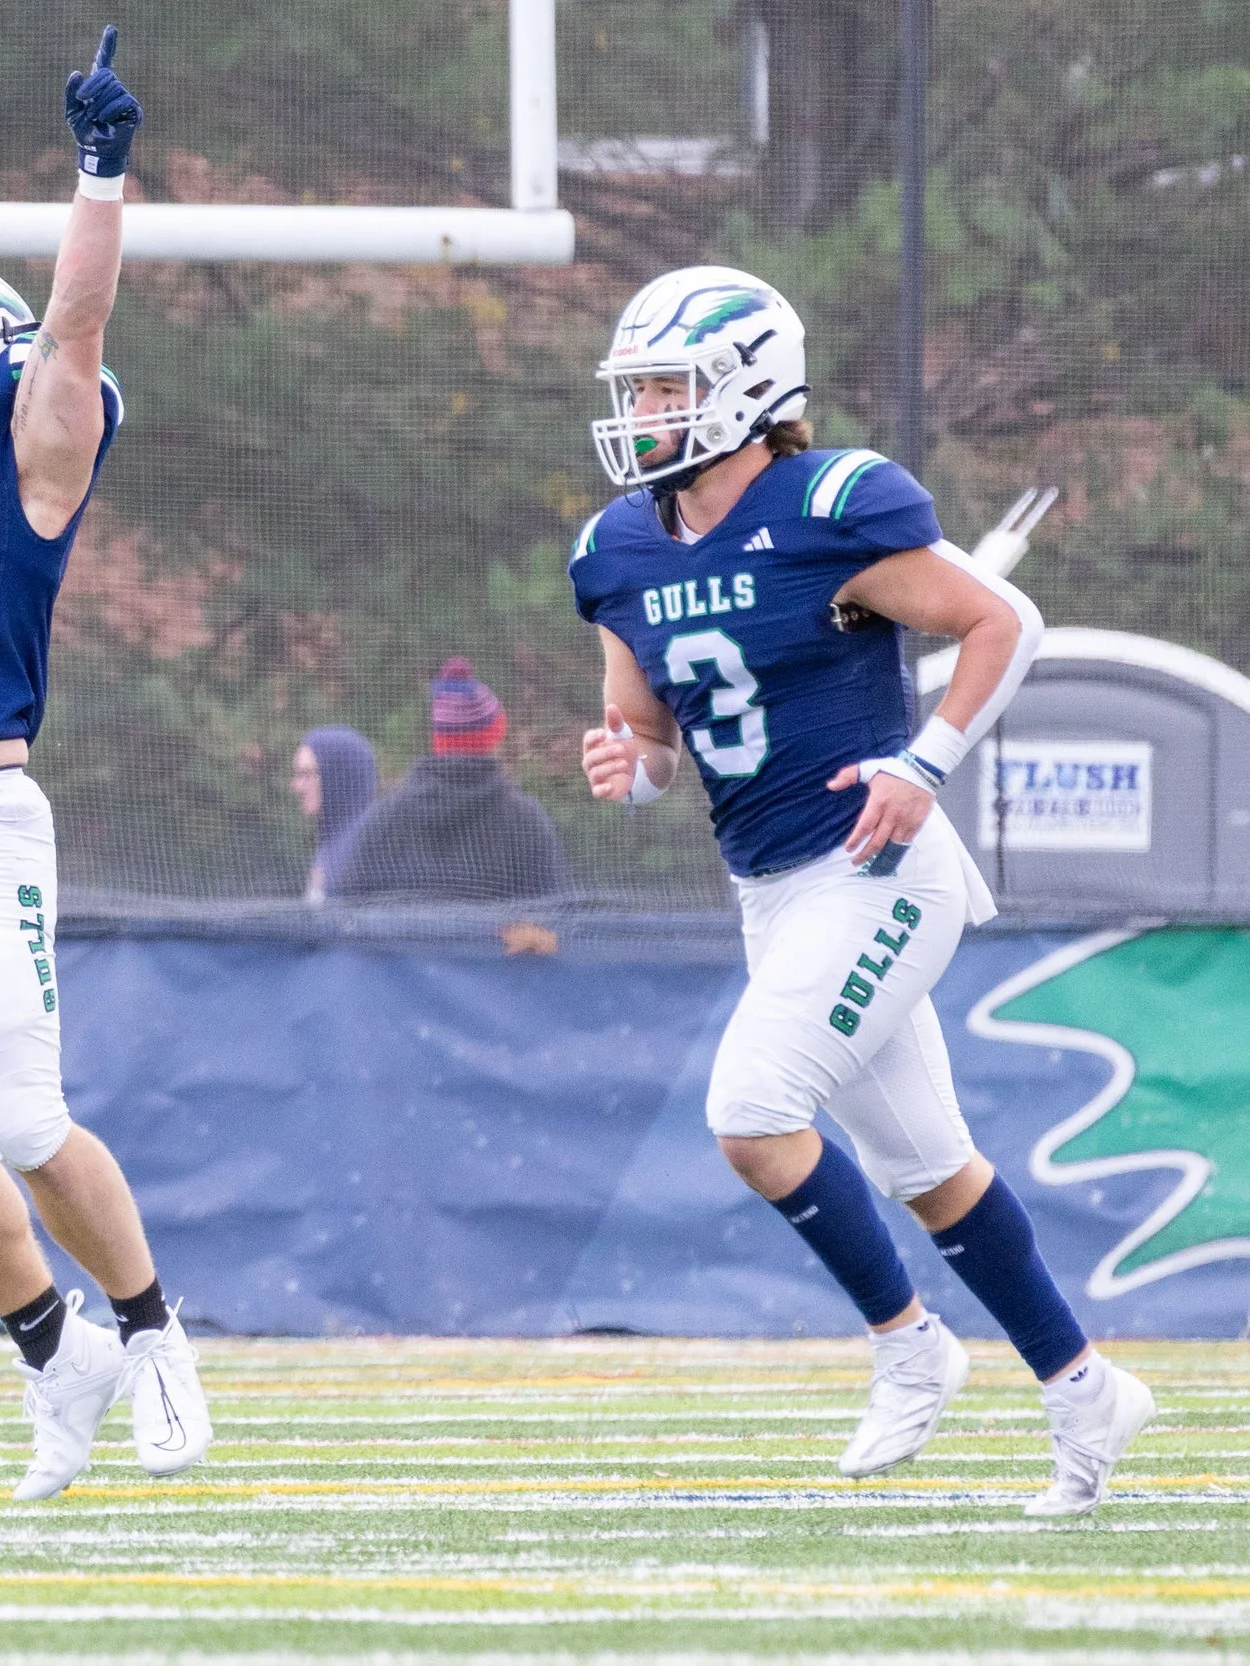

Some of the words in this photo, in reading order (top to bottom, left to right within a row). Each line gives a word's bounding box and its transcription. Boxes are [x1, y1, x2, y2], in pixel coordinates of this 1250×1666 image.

[643, 573, 756, 626] GULLS
[664, 627, 770, 779] 3
[17, 884, 56, 1013] GULLS
[829, 897, 922, 1038] GULLS
